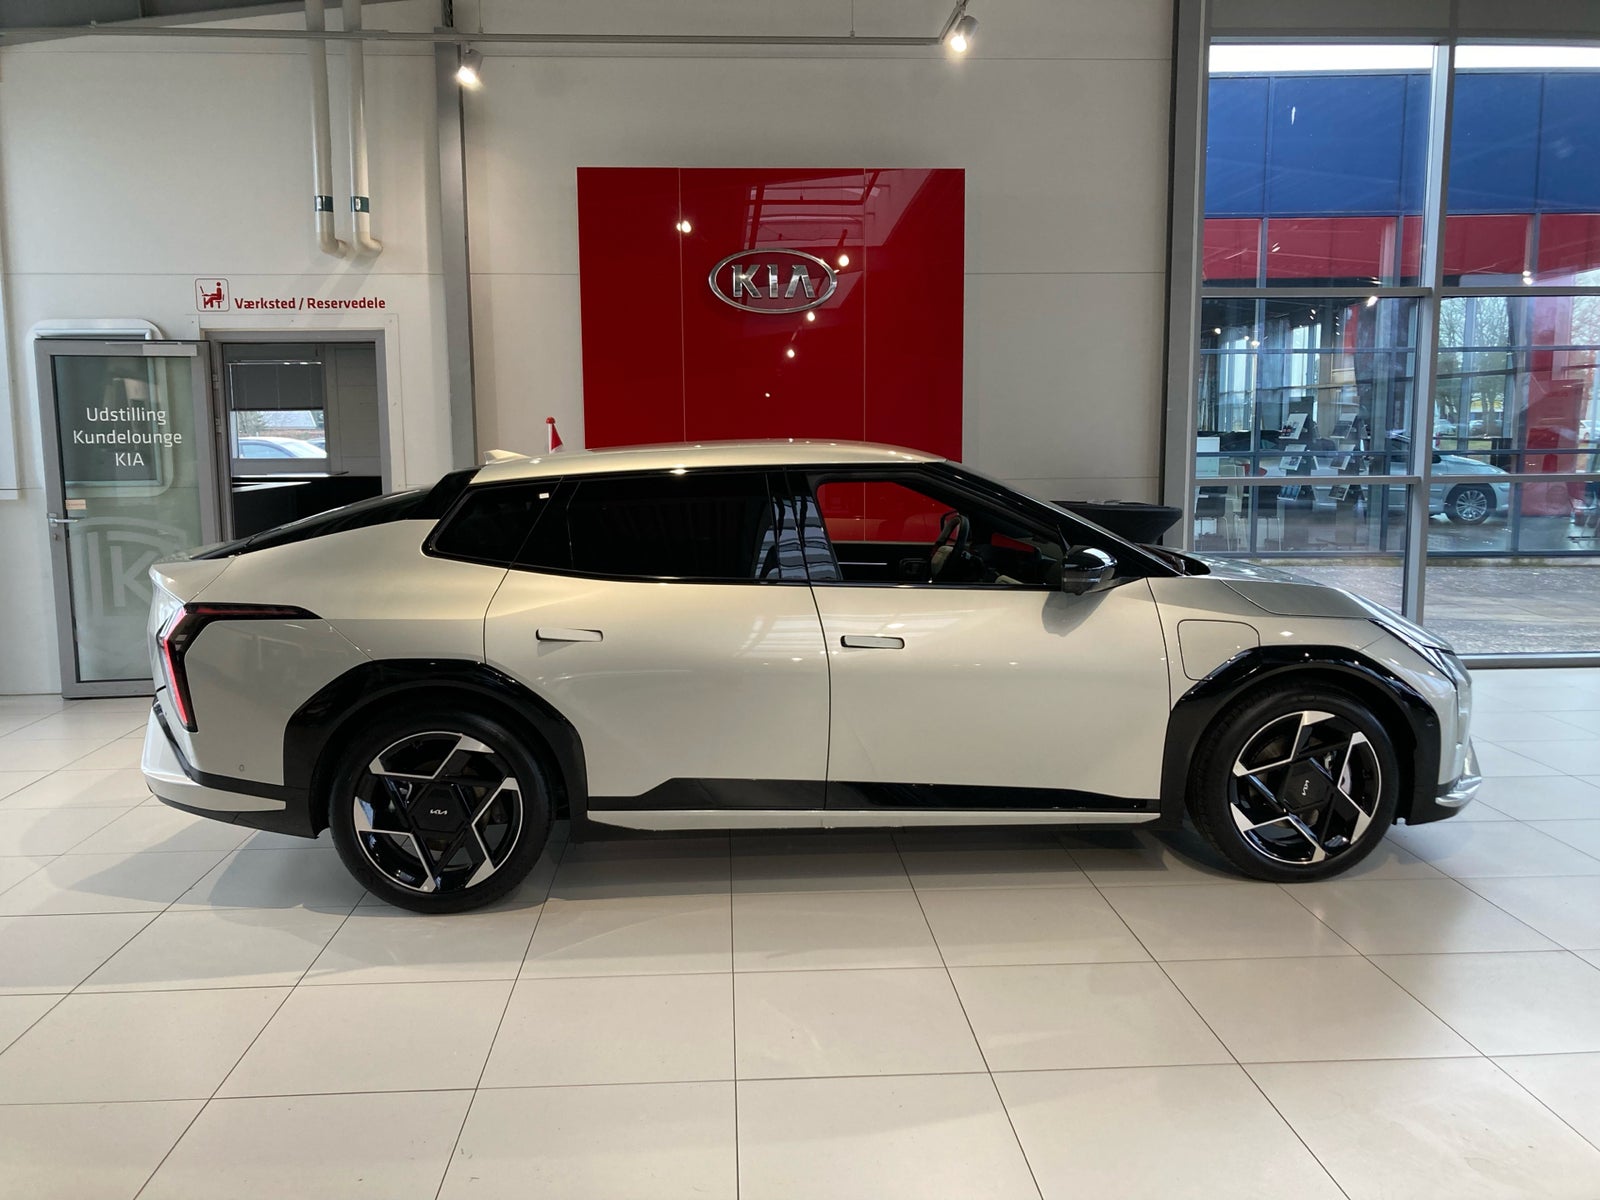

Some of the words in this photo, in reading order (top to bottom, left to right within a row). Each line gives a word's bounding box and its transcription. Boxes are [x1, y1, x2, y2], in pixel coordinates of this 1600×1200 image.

[731, 264, 816, 298] KIA
[234, 297, 296, 309] Værksted
[307, 296, 386, 309] Reservedele
[86, 407, 167, 426] Udstilling
[73, 429, 182, 448] Kundelounge
[115, 452, 145, 467] KIA
